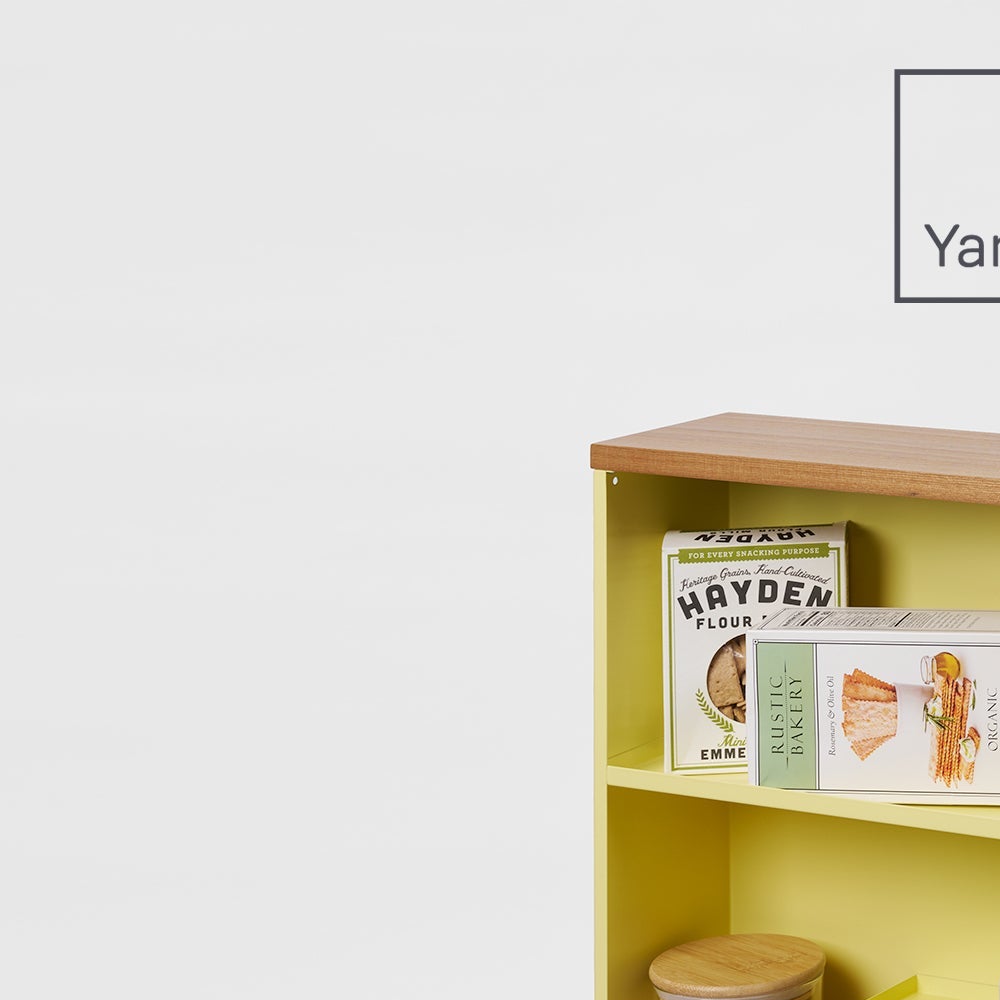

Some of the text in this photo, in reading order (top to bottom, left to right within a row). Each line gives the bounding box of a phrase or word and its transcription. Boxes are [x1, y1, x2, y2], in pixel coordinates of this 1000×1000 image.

[694, 529, 816, 543] HAYDEN
[688, 547, 820, 560] FOR EVERY SNACKING PURPOSE
[679, 574, 718, 592] Heritage
[754, 563, 832, 586] Hand-Cultivated
[677, 579, 833, 620] HAYDEN
[696, 615, 752, 630] FLOUR
[769, 676, 784, 754] RUSTIC
[788, 676, 803, 755] BAKERY
[826, 675, 838, 756] Rosemary & Olive Oil
[987, 687, 998, 752] ORGANIC
[700, 747, 746, 760] EMME
[718, 733, 747, 748] Mini
